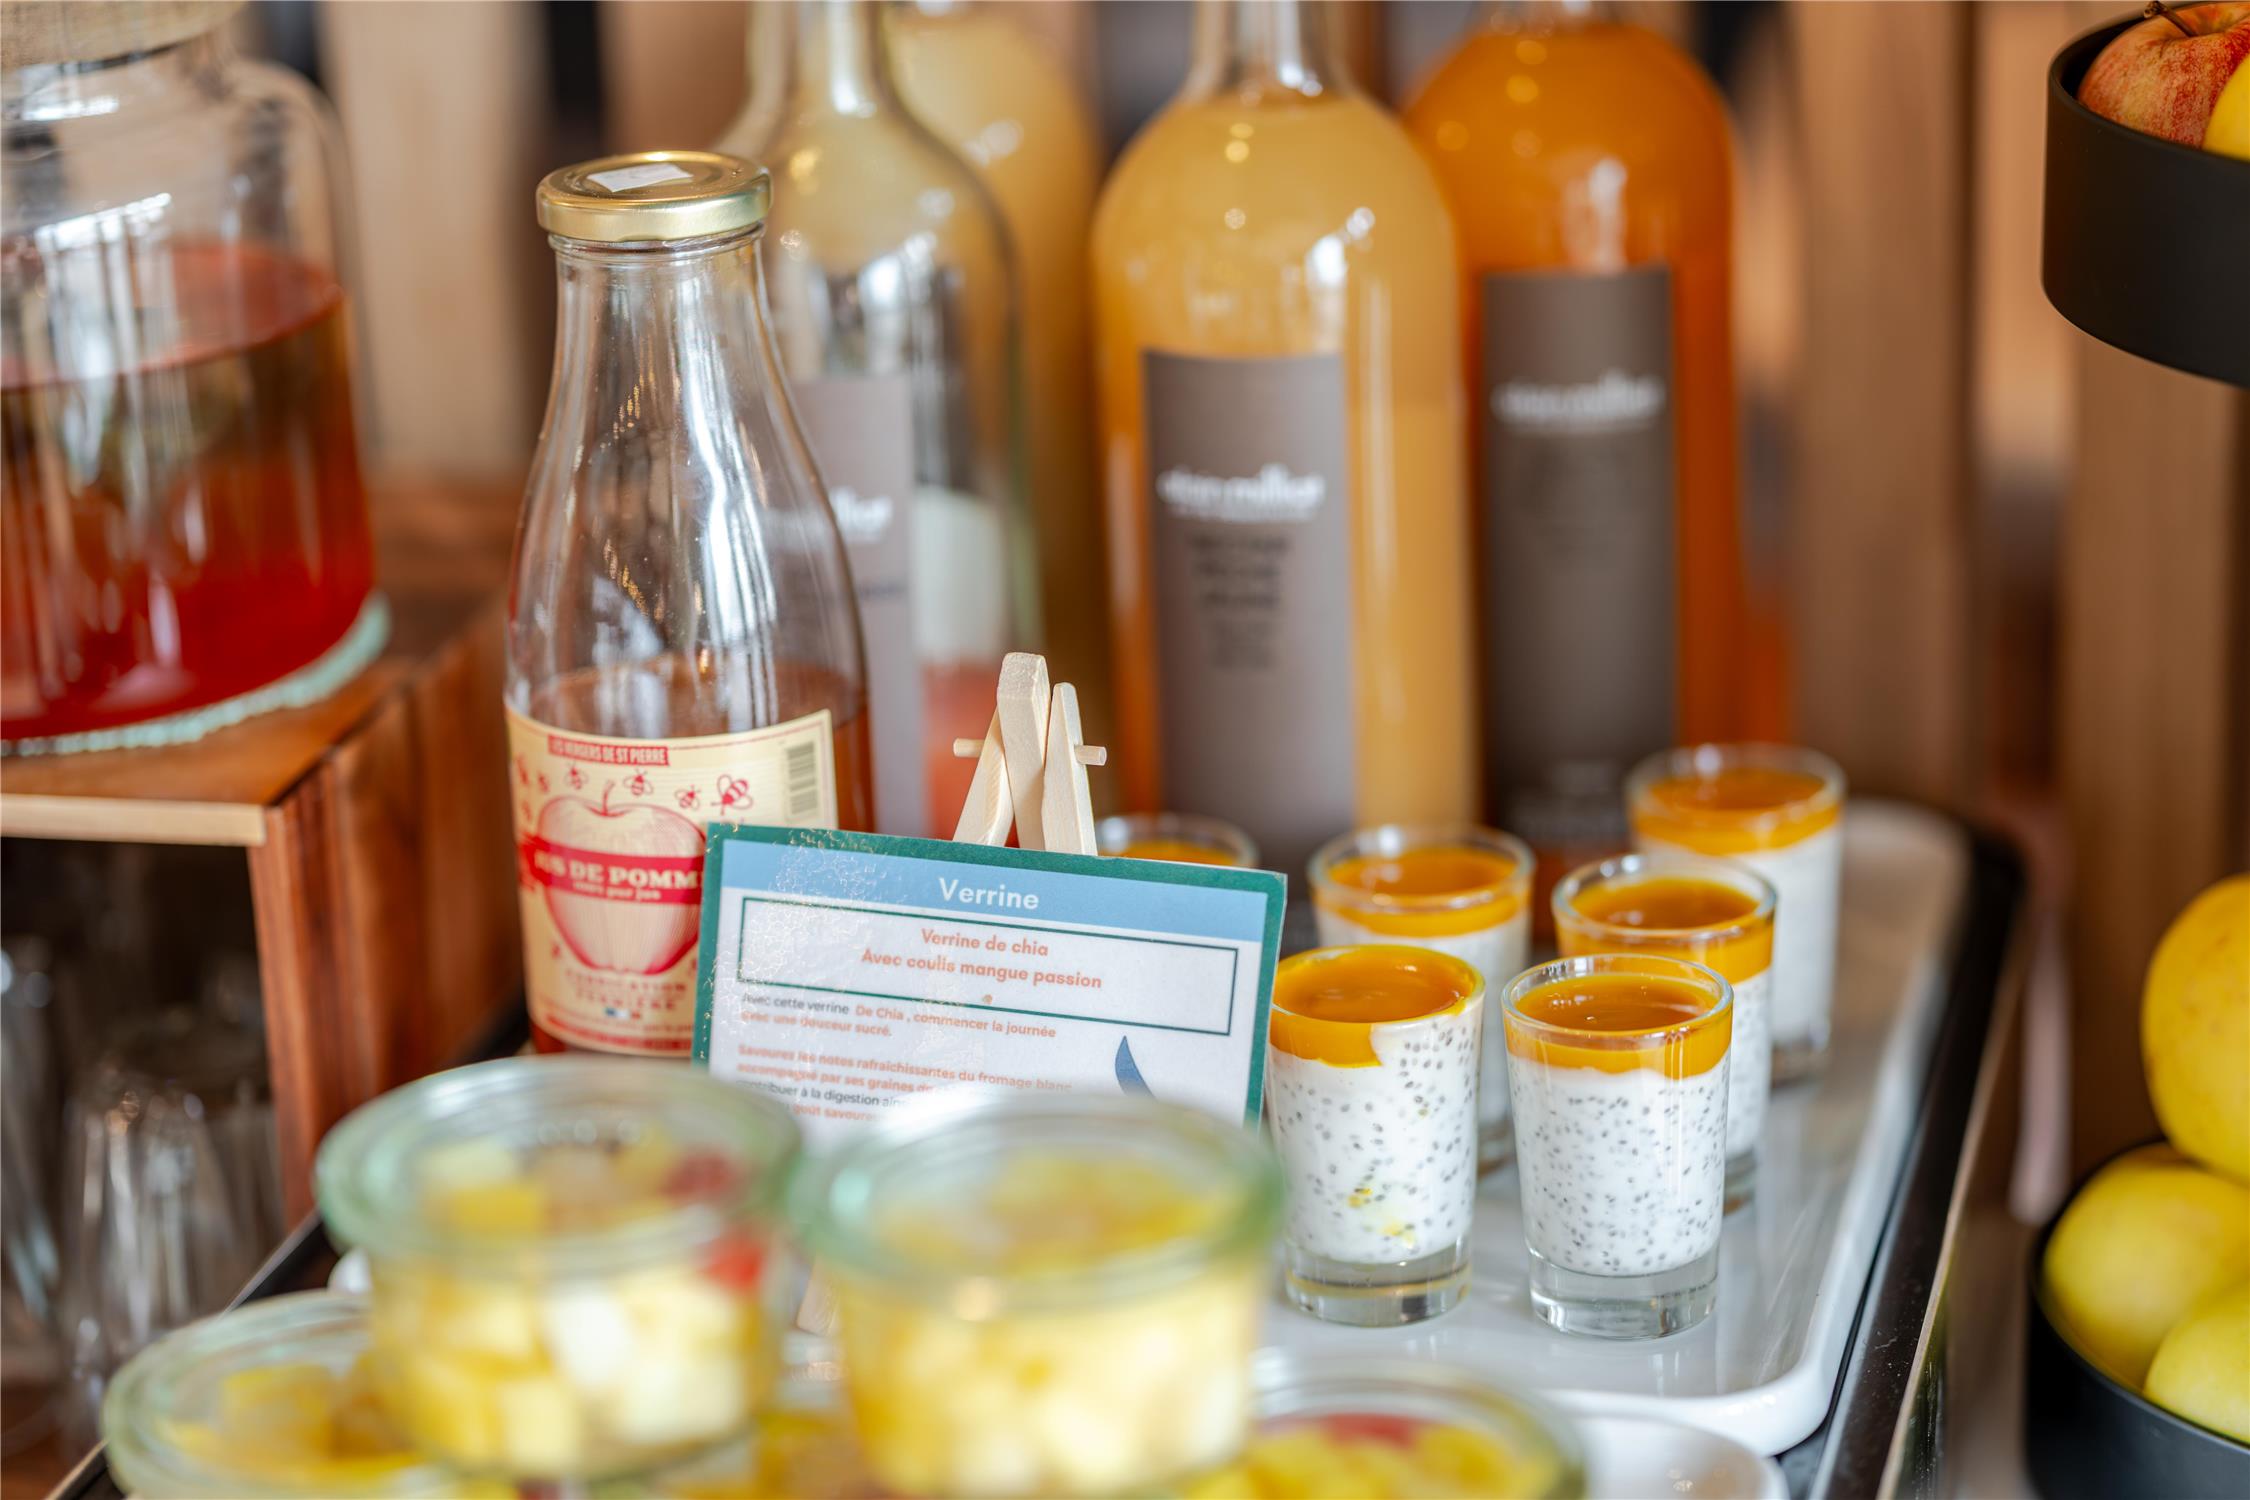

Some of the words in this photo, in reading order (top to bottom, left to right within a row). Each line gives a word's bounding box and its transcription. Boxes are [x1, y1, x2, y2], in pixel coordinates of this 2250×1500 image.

[602, 745, 615, 762] DE
[616, 746, 628, 763] ST
[630, 747, 665, 764] PIERRE
[570, 860, 604, 882] DE
[607, 866, 702, 889] POMM
[938, 877, 1040, 910] Verrine
[921, 928, 980, 949] Verrine
[985, 934, 1005, 952] de
[1011, 937, 1048, 957] chia
[862, 948, 901, 967] Avec
[906, 955, 955, 973] coulis
[960, 963, 1029, 983] mangue
[1033, 969, 1102, 989] passion
[774, 996, 805, 1010] cette
[807, 1000, 850, 1014] verrine
[855, 1004, 872, 1017] De
[876, 1006, 904, 1021] Chia
[914, 1012, 989, 1031] commencer
[992, 1019, 1003, 1032] la
[1006, 1021, 1057, 1038] journée
[774, 1014, 797, 1025] une
[800, 1017, 852, 1033] douceur
[798, 1049, 816, 1063] les
[819, 1054, 854, 1068] notes
[959, 1070, 975, 1082] du
[978, 1072, 1033, 1090] fromage
[820, 1071, 842, 1085] par
[845, 1074, 865, 1086] ses
[867, 1076, 914, 1092] graines
[801, 1087, 808, 1098] à
[811, 1087, 821, 1099] la
[824, 1089, 880, 1105] digestion
